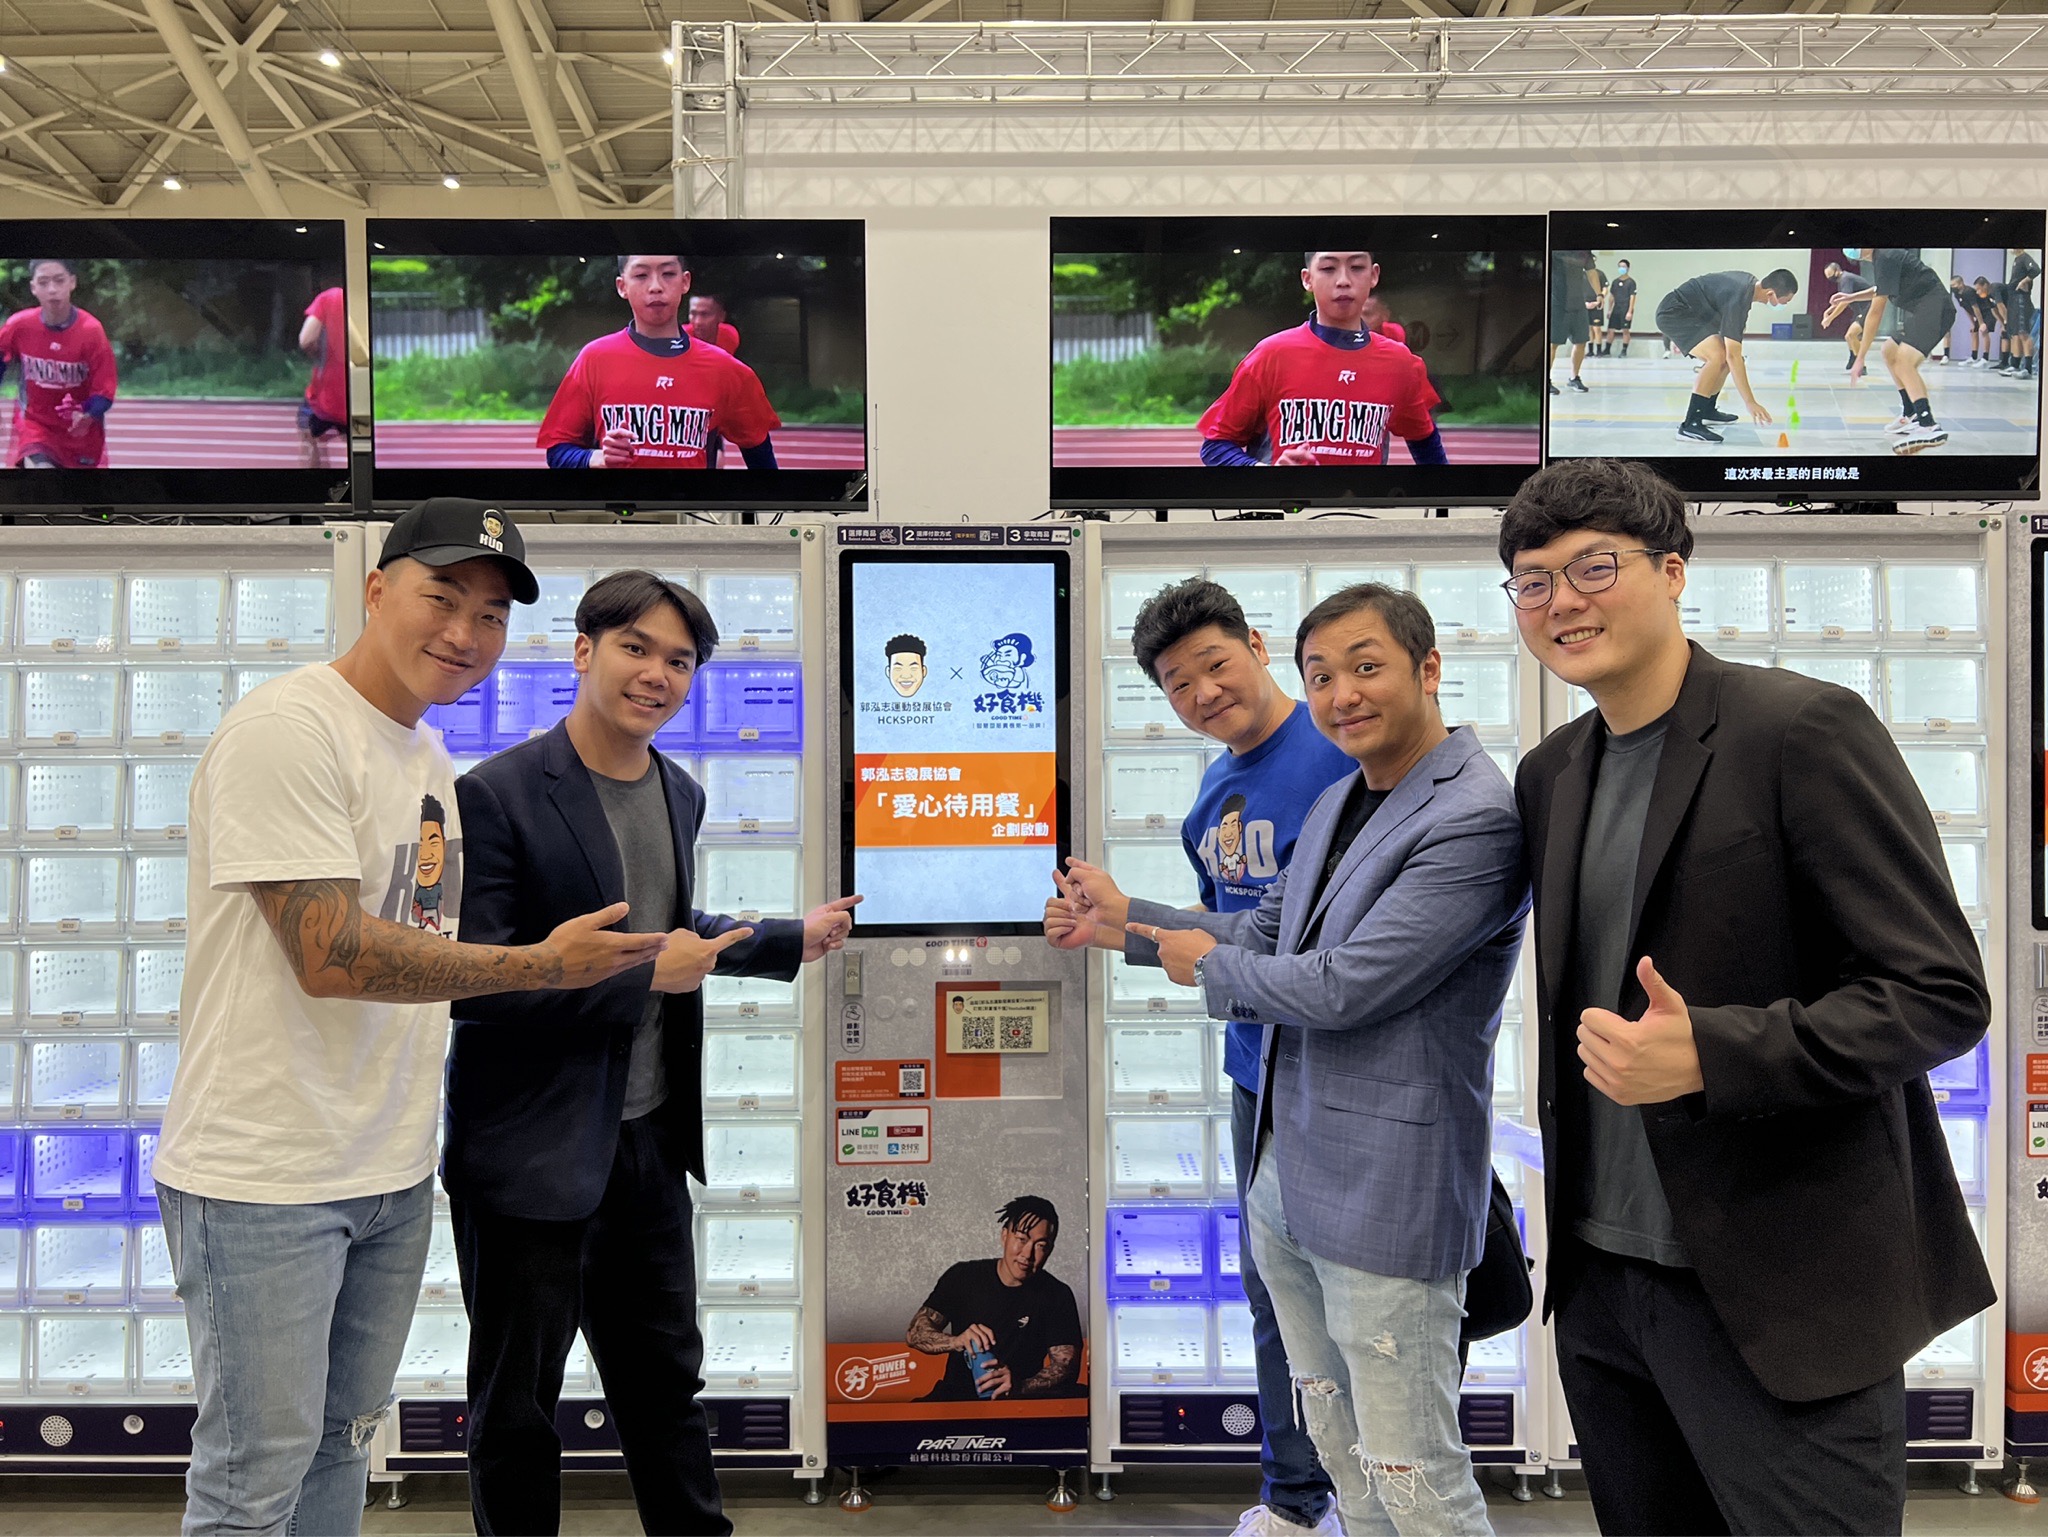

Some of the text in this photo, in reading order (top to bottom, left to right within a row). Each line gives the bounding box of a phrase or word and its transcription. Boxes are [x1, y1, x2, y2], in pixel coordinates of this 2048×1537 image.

[1279, 399, 1346, 446] YANG
[634, 449, 674, 458] ASEBALL
[1309, 446, 1353, 457] ASEBALL
[1724, 467, 1860, 480] 這次來最主要的目的就是
[2034, 518, 2040, 530] 1
[841, 529, 847, 541] 1
[905, 530, 915, 541] 2
[1010, 529, 1021, 542] 3
[860, 701, 953, 712] 郭泓志運動發展協會
[973, 689, 1045, 714] 好食機
[877, 715, 935, 725] HCKSPORT
[861, 767, 962, 782] 郭泓志發展協會
[877, 792, 1036, 819] 「愛心待用餐」
[1225, 886, 1263, 897] HCKSPORT
[841, 1128, 877, 1136] LINE Pay
[846, 1177, 930, 1208] 好食機
[873, 1359, 906, 1375] POWER
[844, 1365, 869, 1393] 夯
[873, 1372, 889, 1382] PLANT
[916, 1435, 1007, 1450] PARTNER
